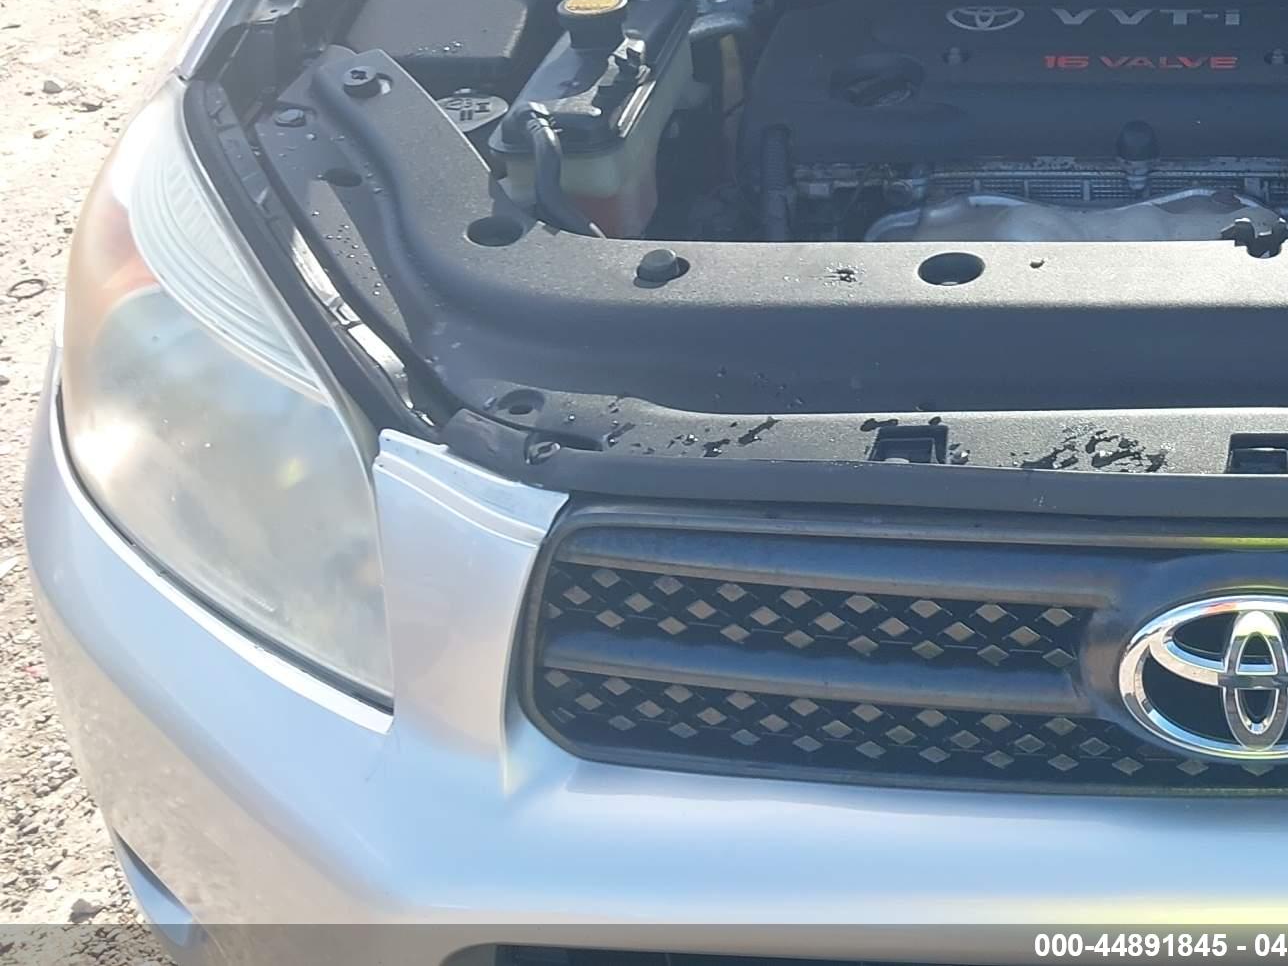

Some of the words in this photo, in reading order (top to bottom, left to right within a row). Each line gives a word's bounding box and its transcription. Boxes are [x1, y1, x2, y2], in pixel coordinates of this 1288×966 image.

[1051, 9, 1240, 25] VVT-i
[1044, 56, 1089, 68] 16
[1100, 56, 1239, 68] VALVE
